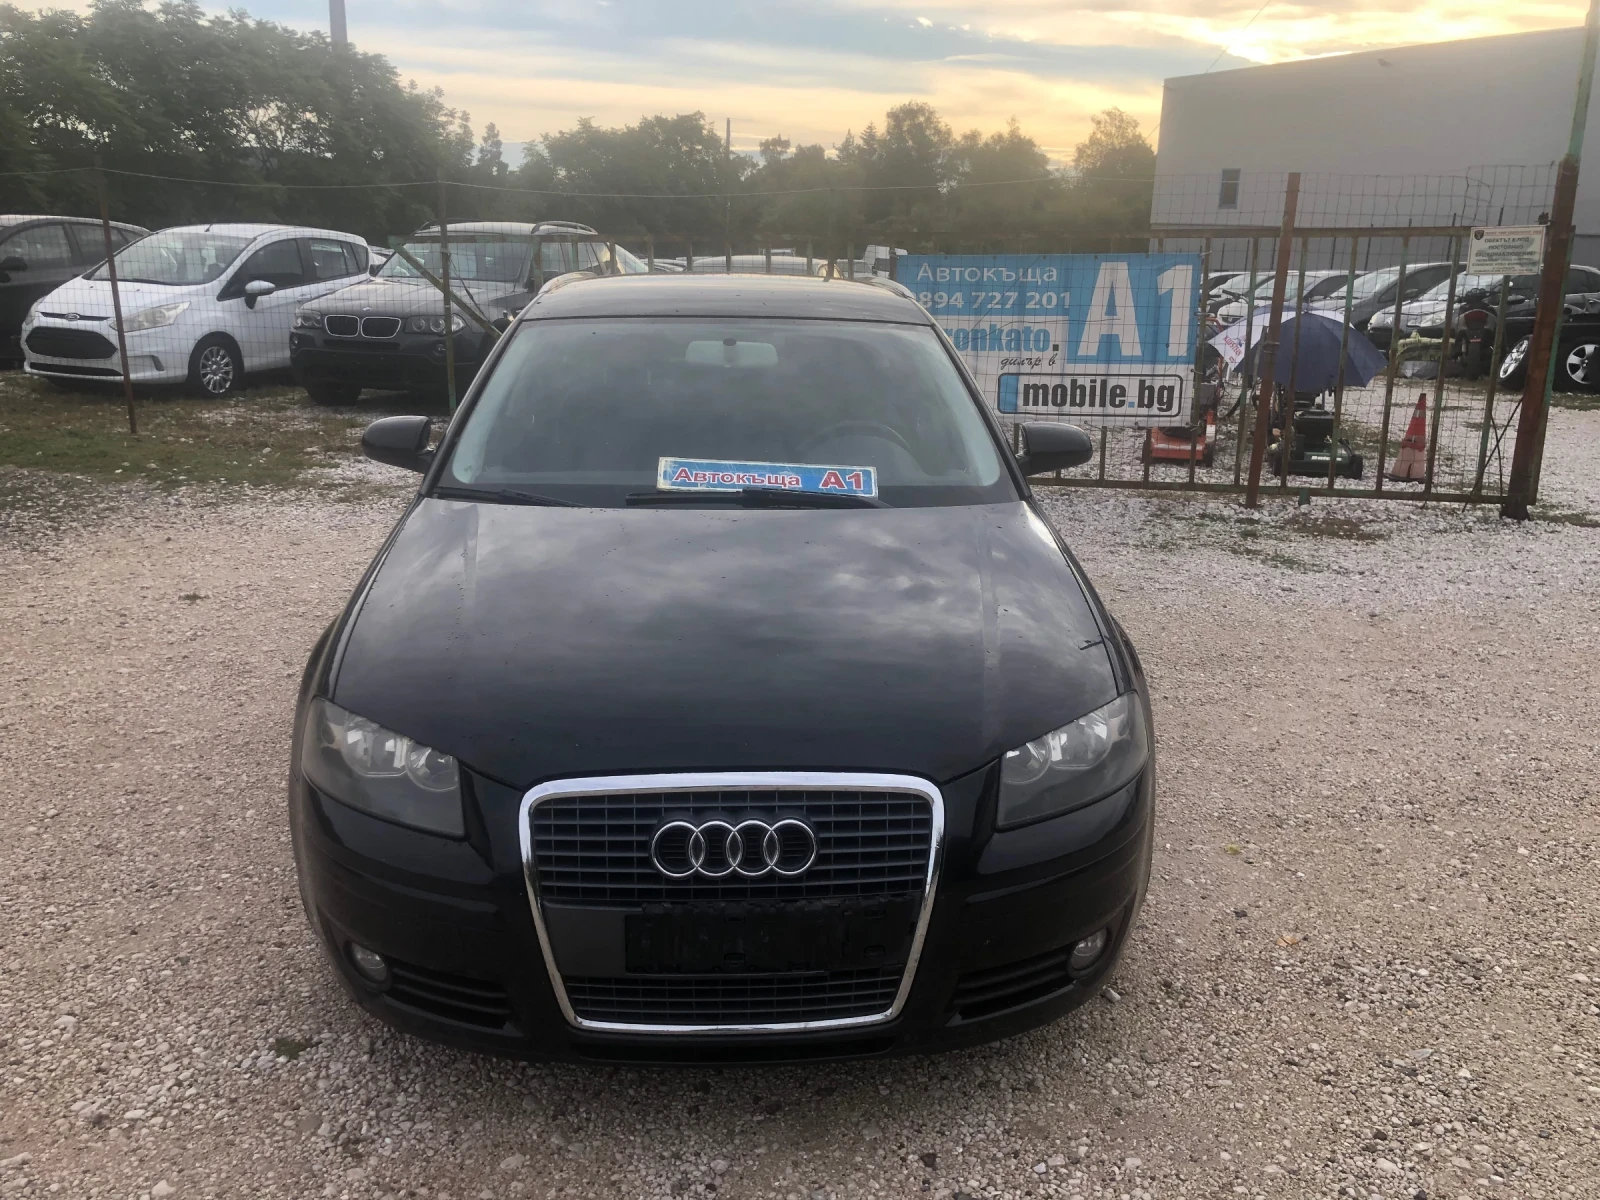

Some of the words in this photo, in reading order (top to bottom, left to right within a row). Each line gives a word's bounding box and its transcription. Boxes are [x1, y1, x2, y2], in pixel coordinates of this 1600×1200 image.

[917, 262, 1057, 283] Автокъща
[913, 290, 964, 309] 894
[971, 291, 1016, 309] 727
[1025, 290, 1070, 309] 201
[1077, 261, 1193, 357] А1
[1022, 378, 1175, 413] mobile.bg
[673, 467, 801, 488] Автокъща
[820, 470, 864, 491] А1
